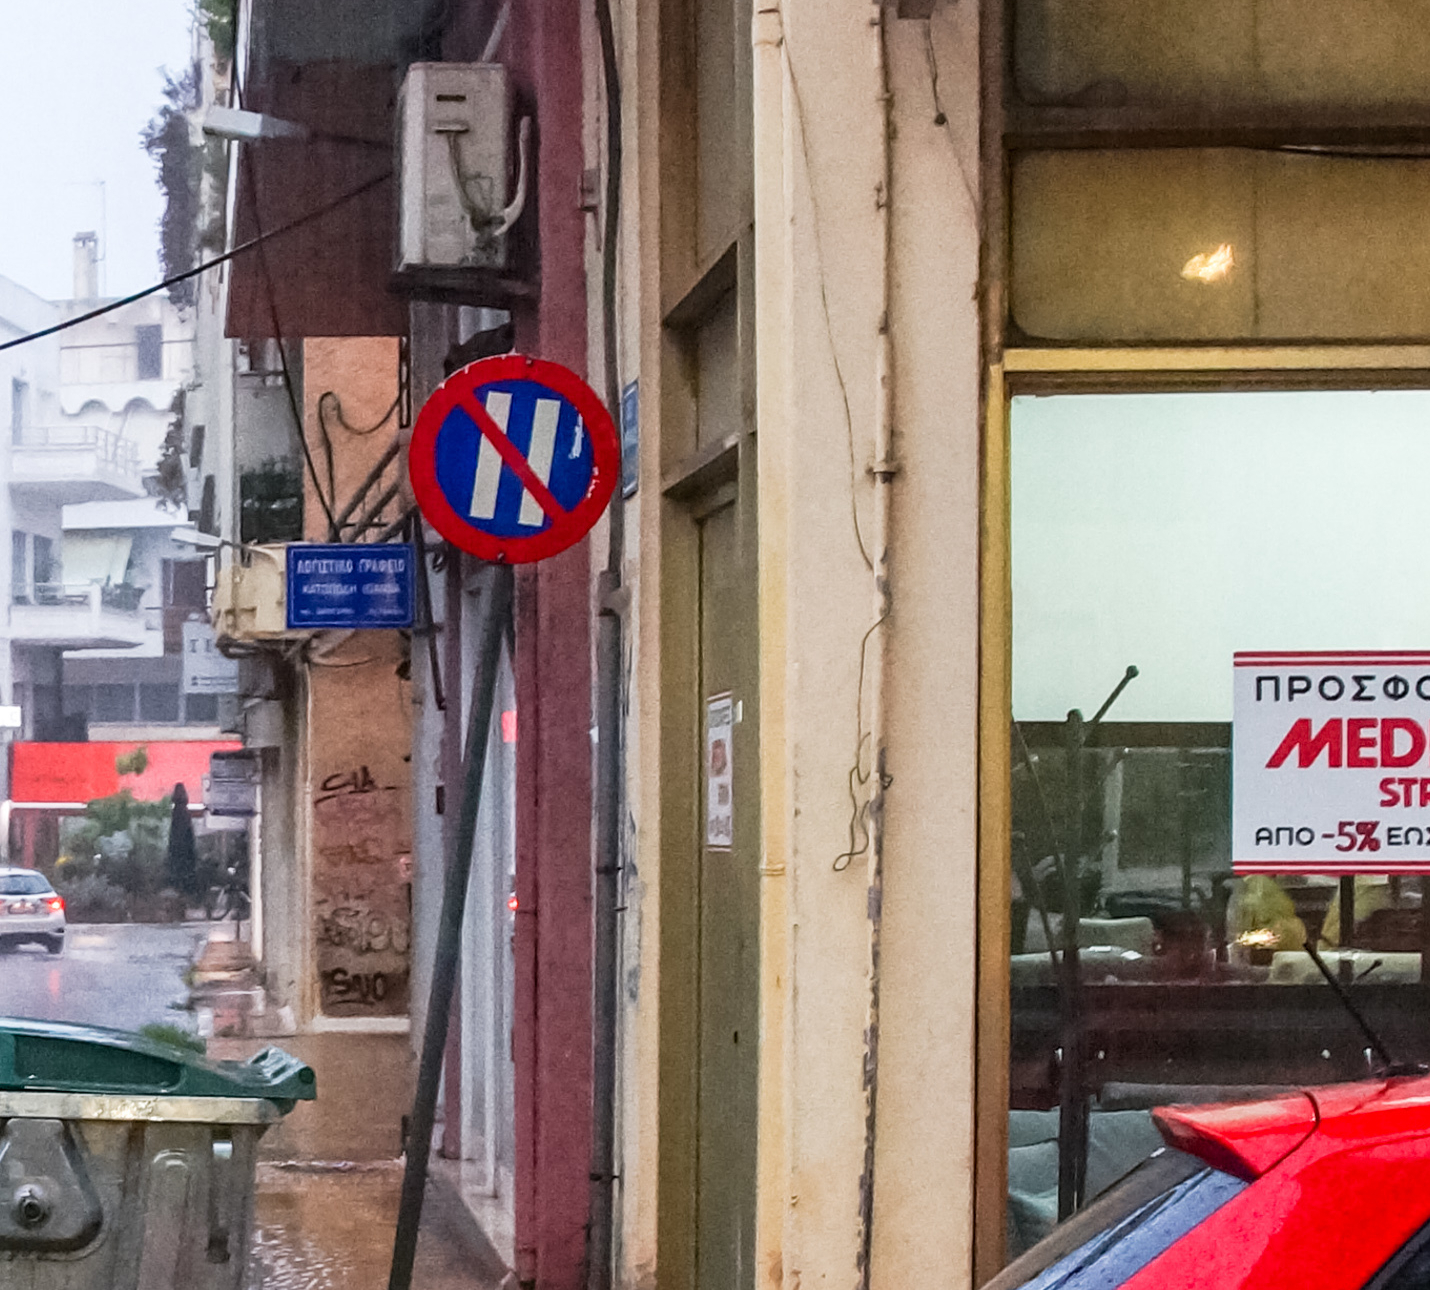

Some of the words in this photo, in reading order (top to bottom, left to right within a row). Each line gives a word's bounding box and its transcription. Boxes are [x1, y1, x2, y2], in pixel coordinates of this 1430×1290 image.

[358, 558, 405, 573] ΓΡΑΦΕΙΟ
[1265, 717, 1430, 769] MED
[1255, 826, 1315, 847] ΑΠΟ
[1321, 820, 1381, 852] -5%
[1387, 826, 1430, 847] ΕΩ
